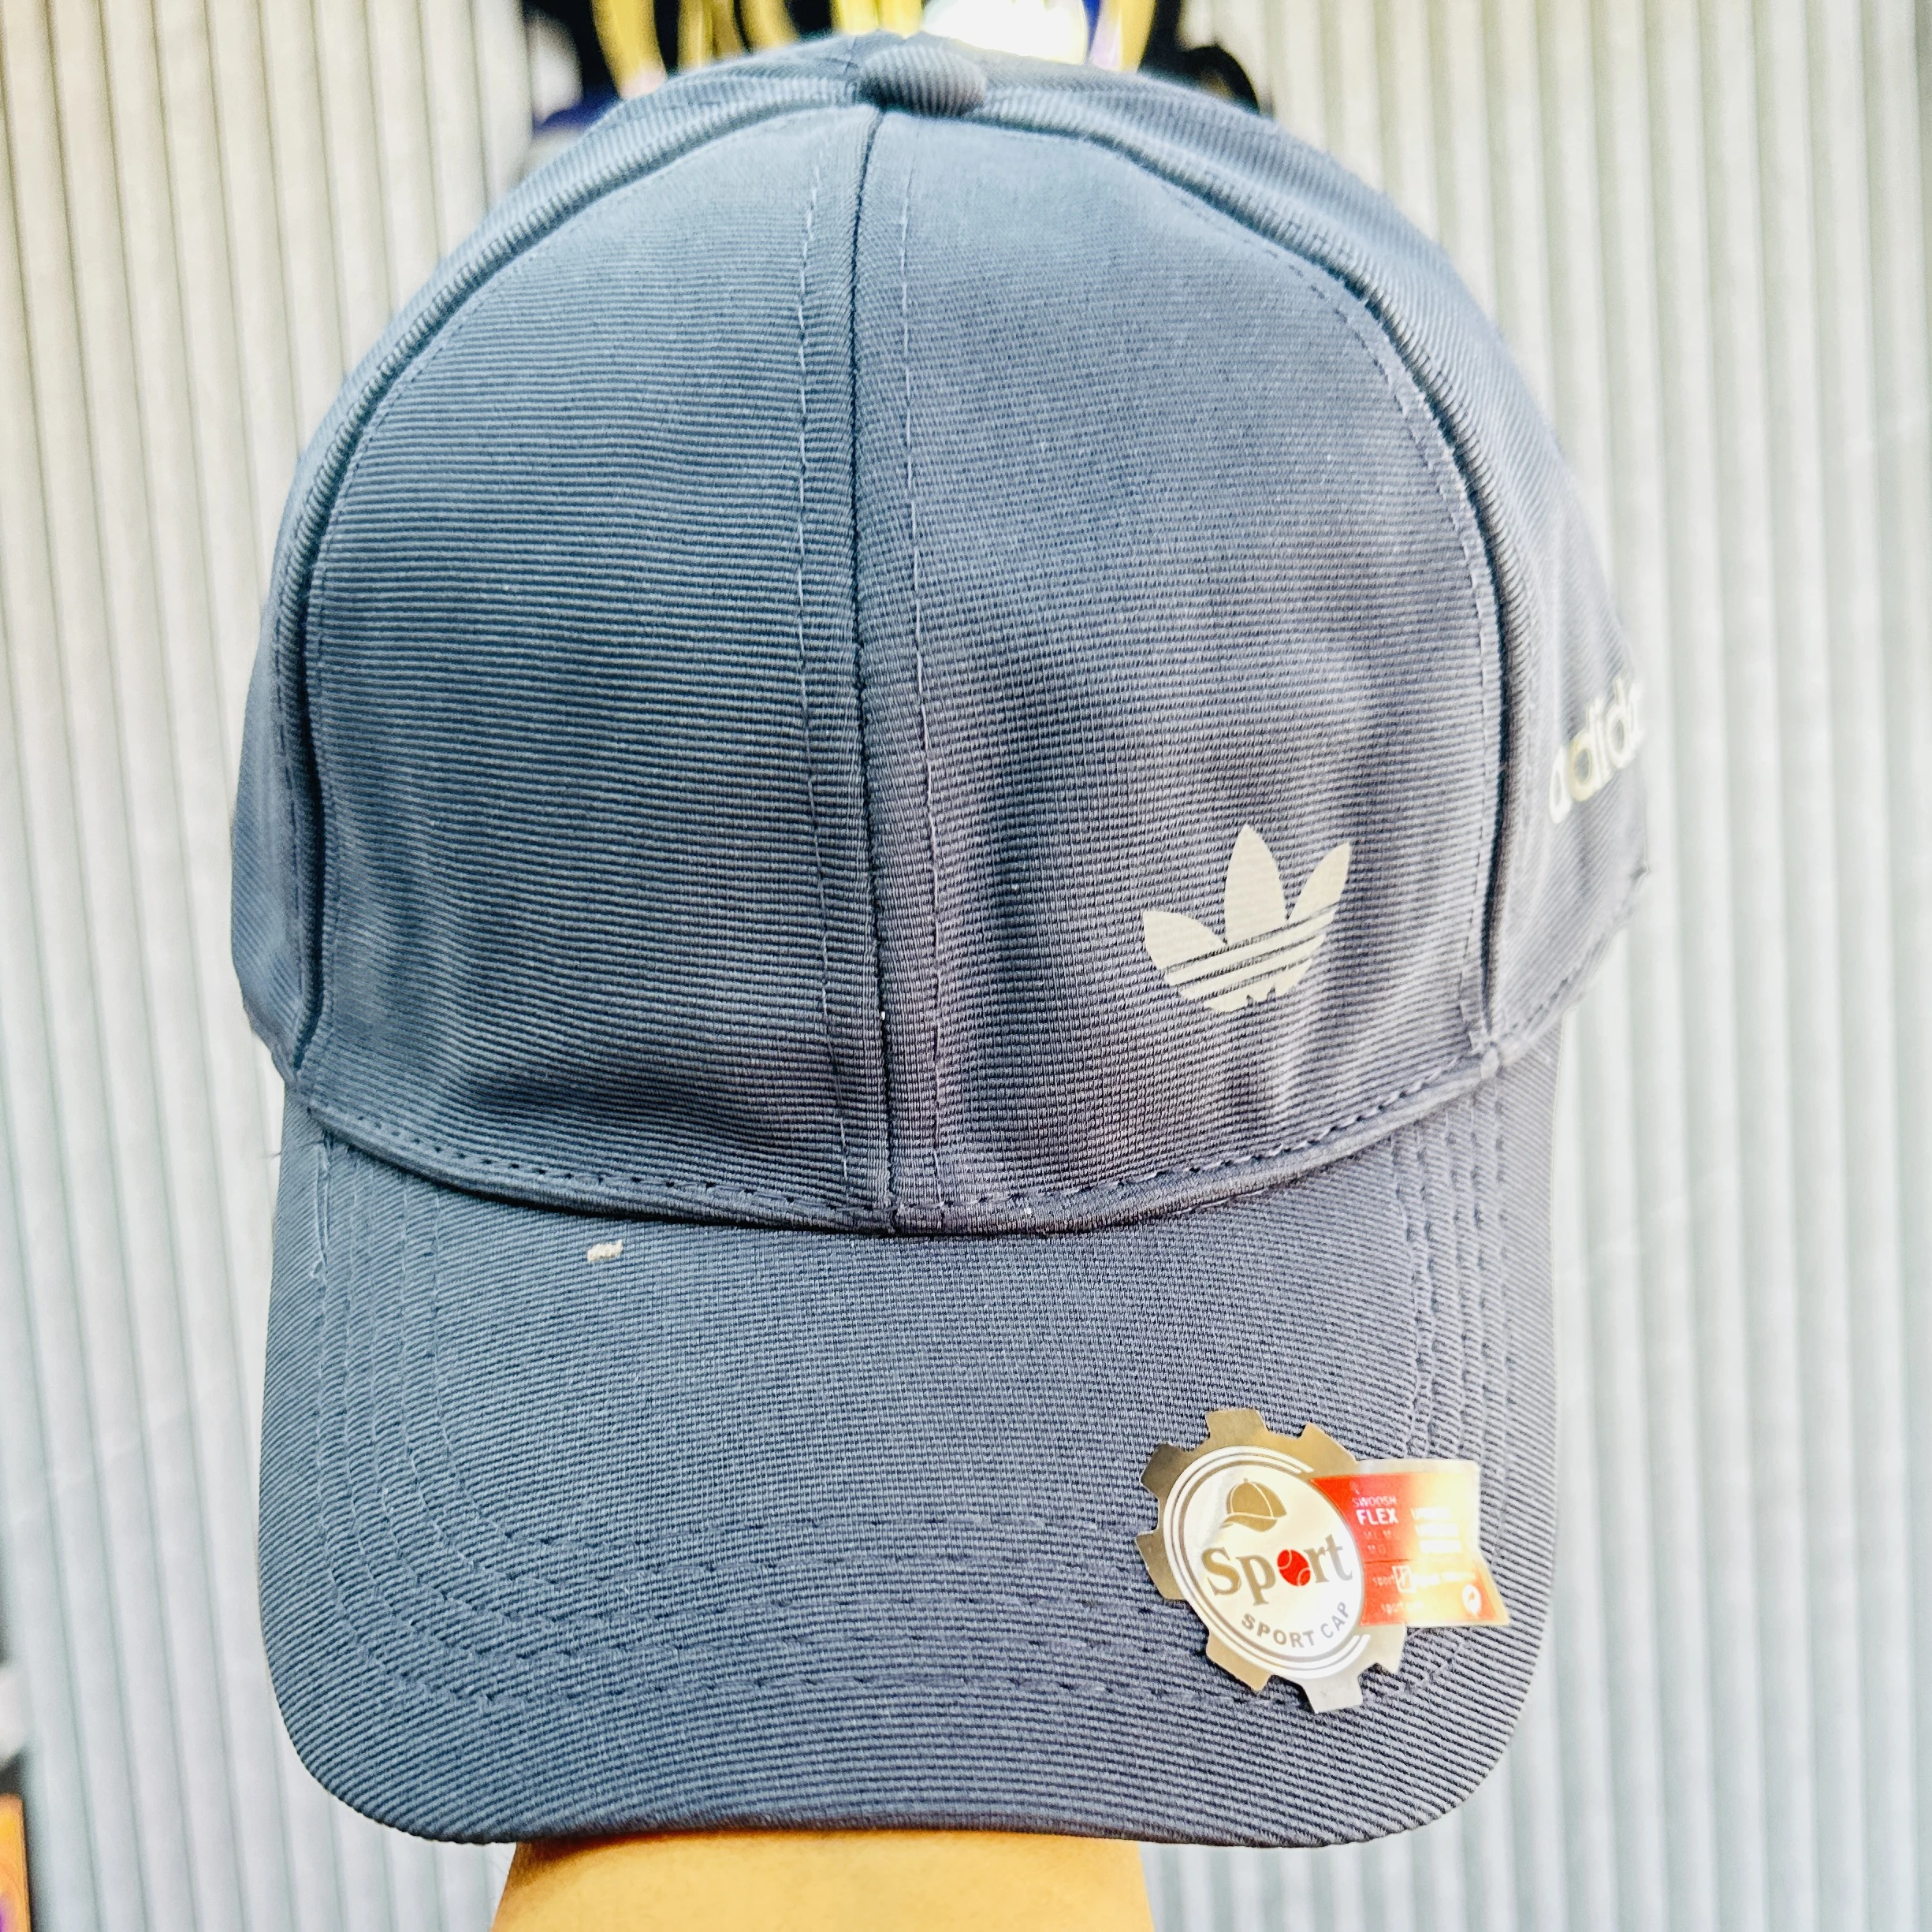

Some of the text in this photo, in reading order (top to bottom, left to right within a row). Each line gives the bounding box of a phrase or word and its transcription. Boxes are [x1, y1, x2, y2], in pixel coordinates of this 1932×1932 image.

[1352, 1495, 1397, 1507] SWOOSH
[1356, 1507, 1399, 1525] FLEX
[1201, 1534, 1353, 1606] Sport
[1241, 1601, 1349, 1648] SPORT CAP
